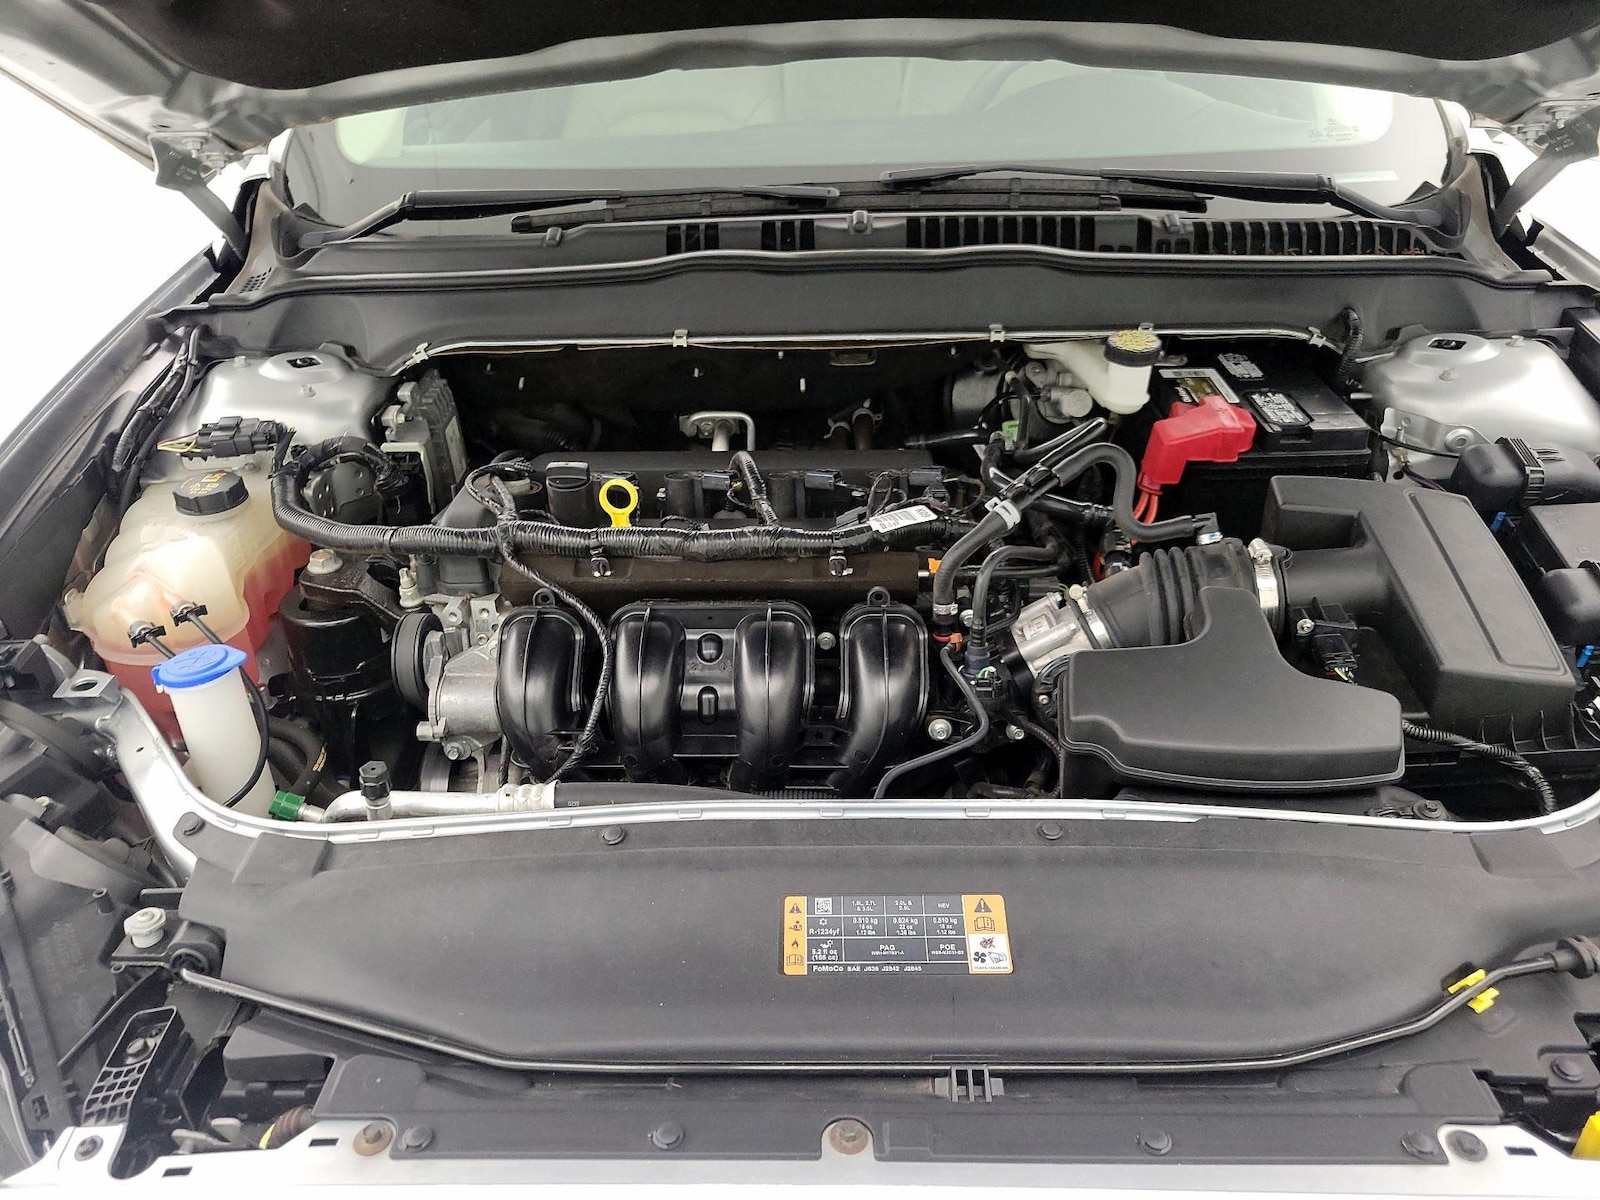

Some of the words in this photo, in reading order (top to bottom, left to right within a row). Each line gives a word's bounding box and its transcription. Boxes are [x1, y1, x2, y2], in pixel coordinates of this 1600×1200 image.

[870, 917, 878, 925] kg
[910, 917, 919, 925] kg
[950, 917, 958, 925] kg
[809, 928, 840, 936] R-1234yf
[827, 954, 839, 962] cc)
[812, 965, 844, 973] FoMoCo
